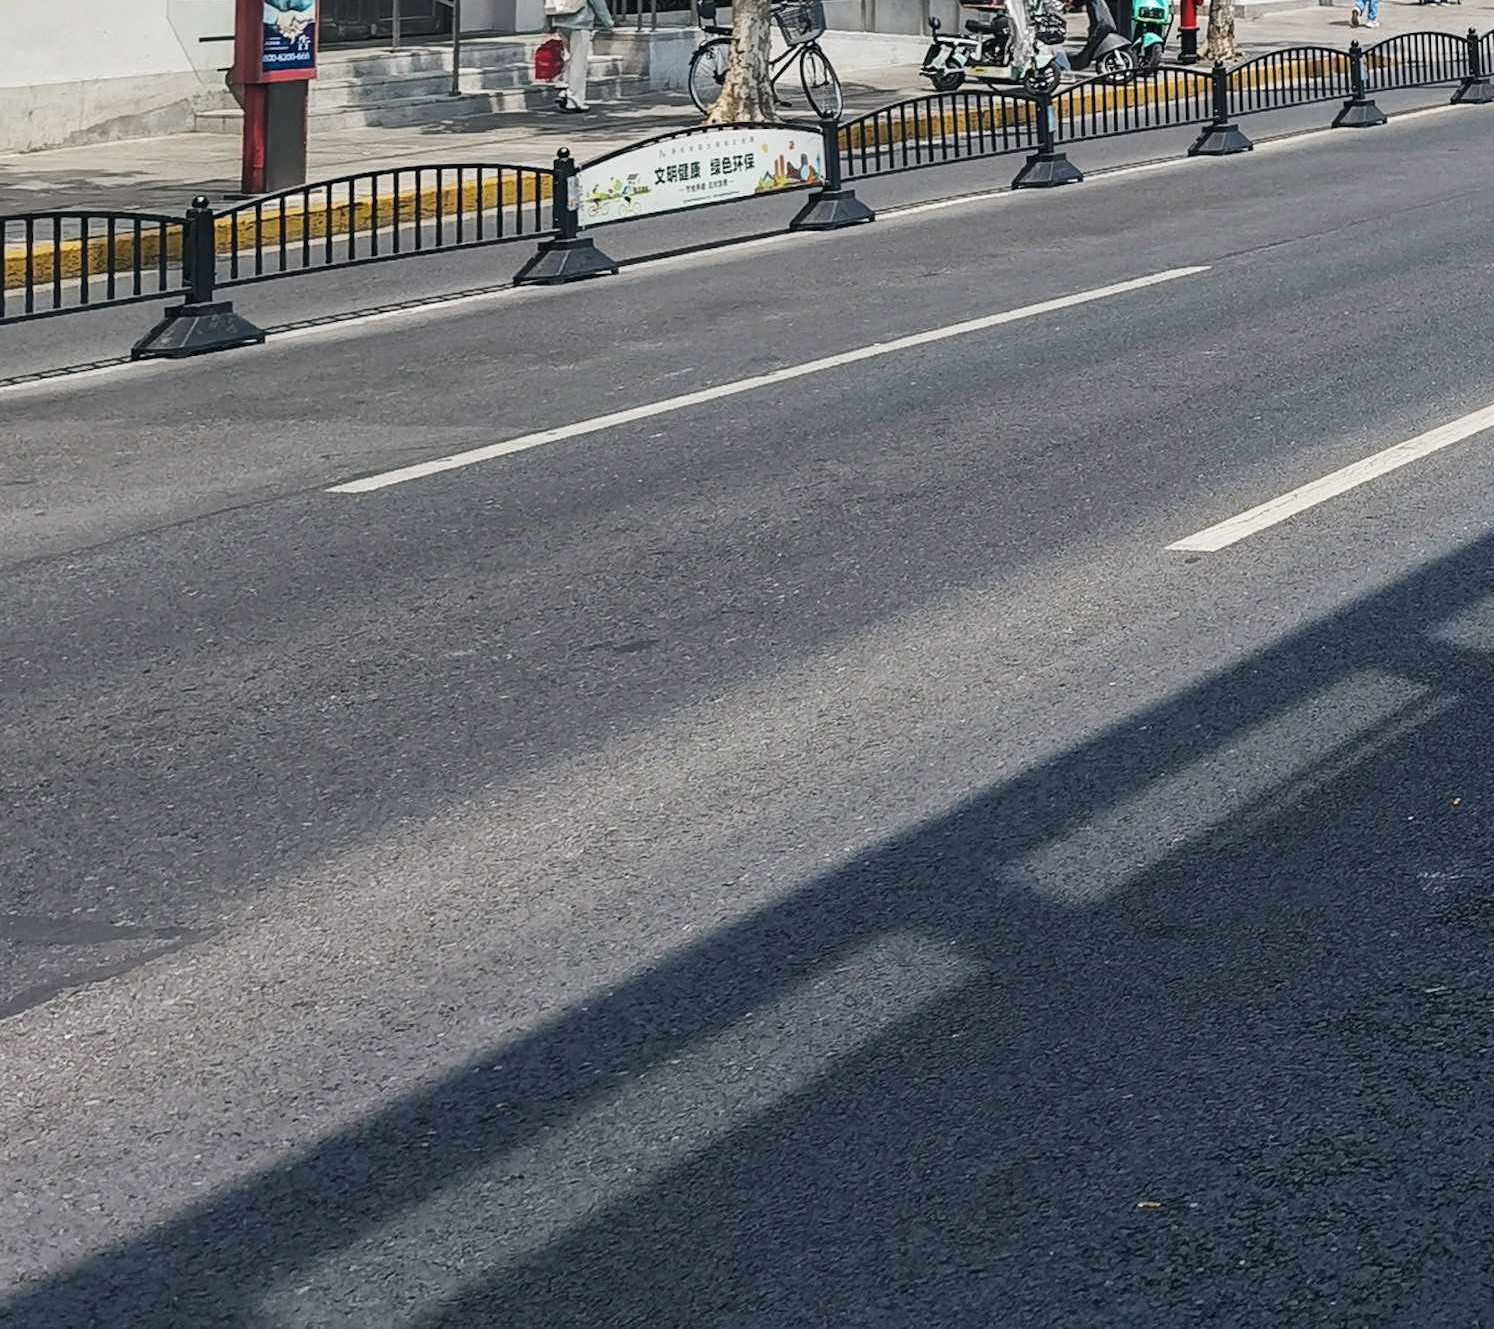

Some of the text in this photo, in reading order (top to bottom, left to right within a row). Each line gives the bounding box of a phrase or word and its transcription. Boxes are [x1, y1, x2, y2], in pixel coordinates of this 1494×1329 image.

[654, 153, 755, 185] 文明健康 绿色环保
